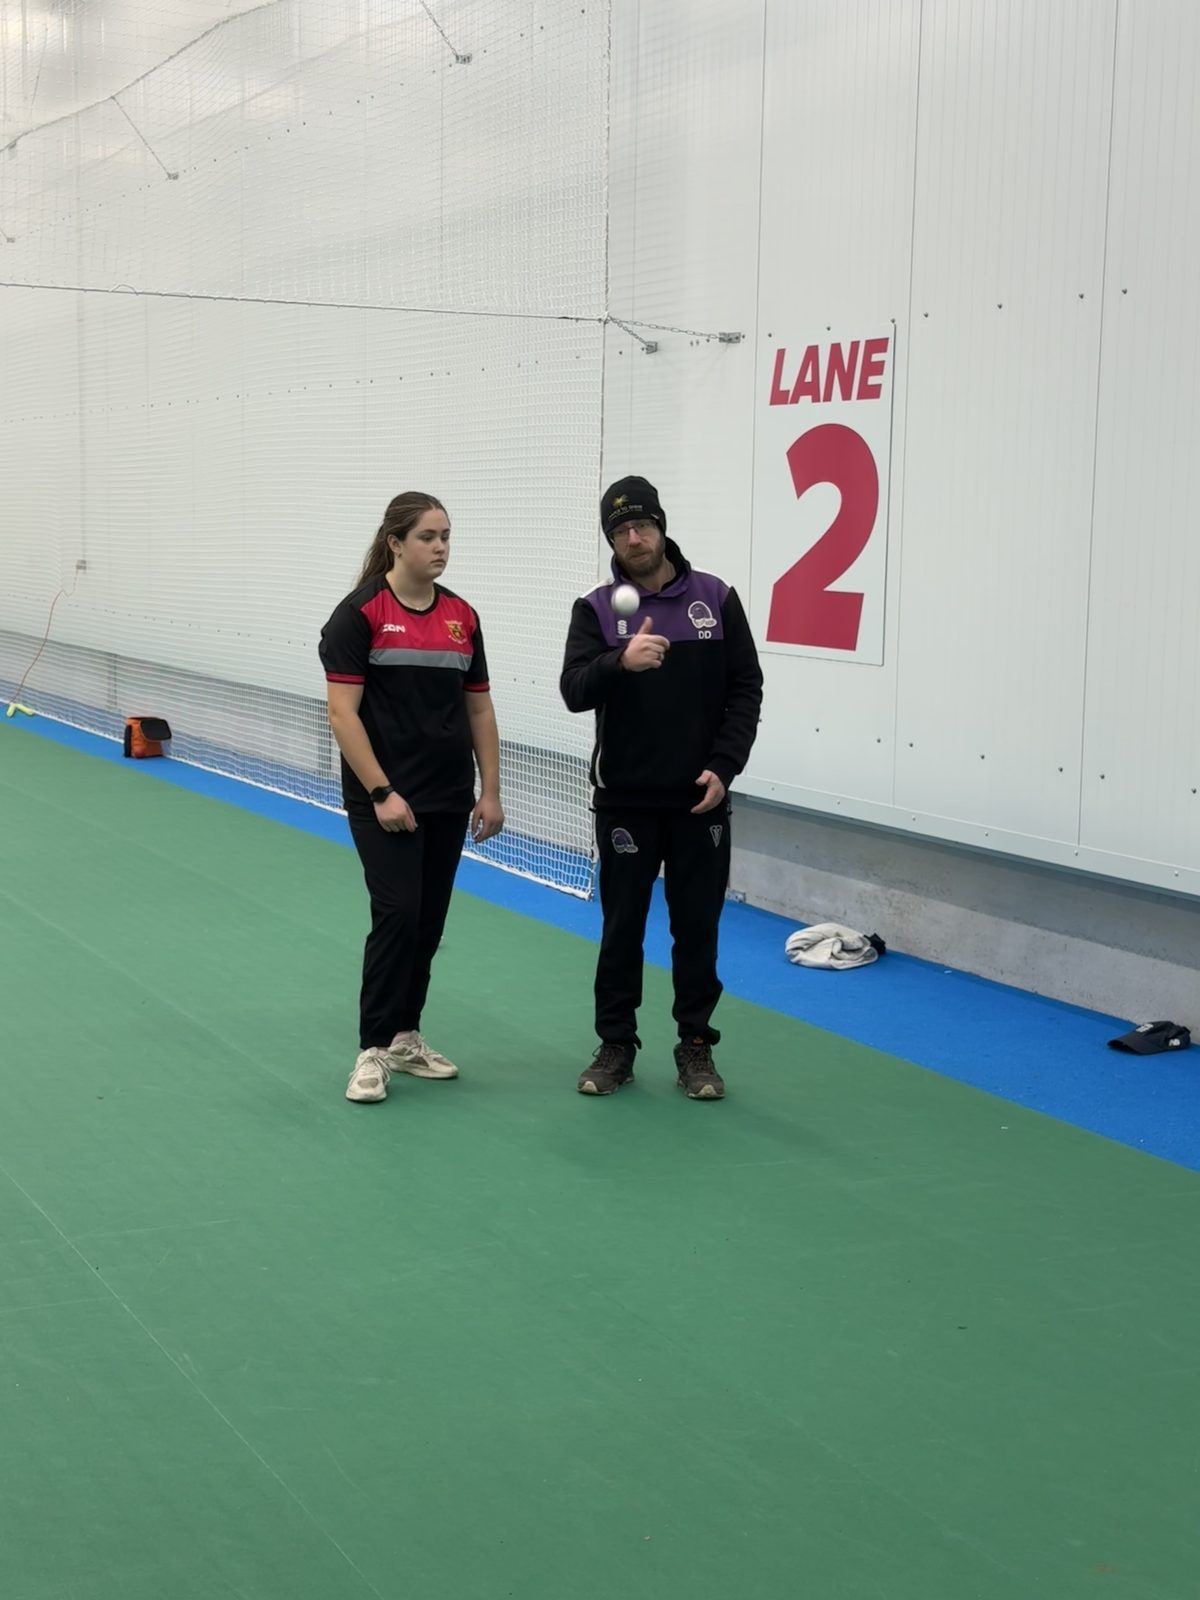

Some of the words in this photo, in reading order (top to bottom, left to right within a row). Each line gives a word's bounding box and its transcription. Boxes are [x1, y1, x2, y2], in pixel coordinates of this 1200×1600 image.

[769, 337, 889, 406] LANE
[766, 423, 879, 652] 2
[698, 630, 711, 639] DD
